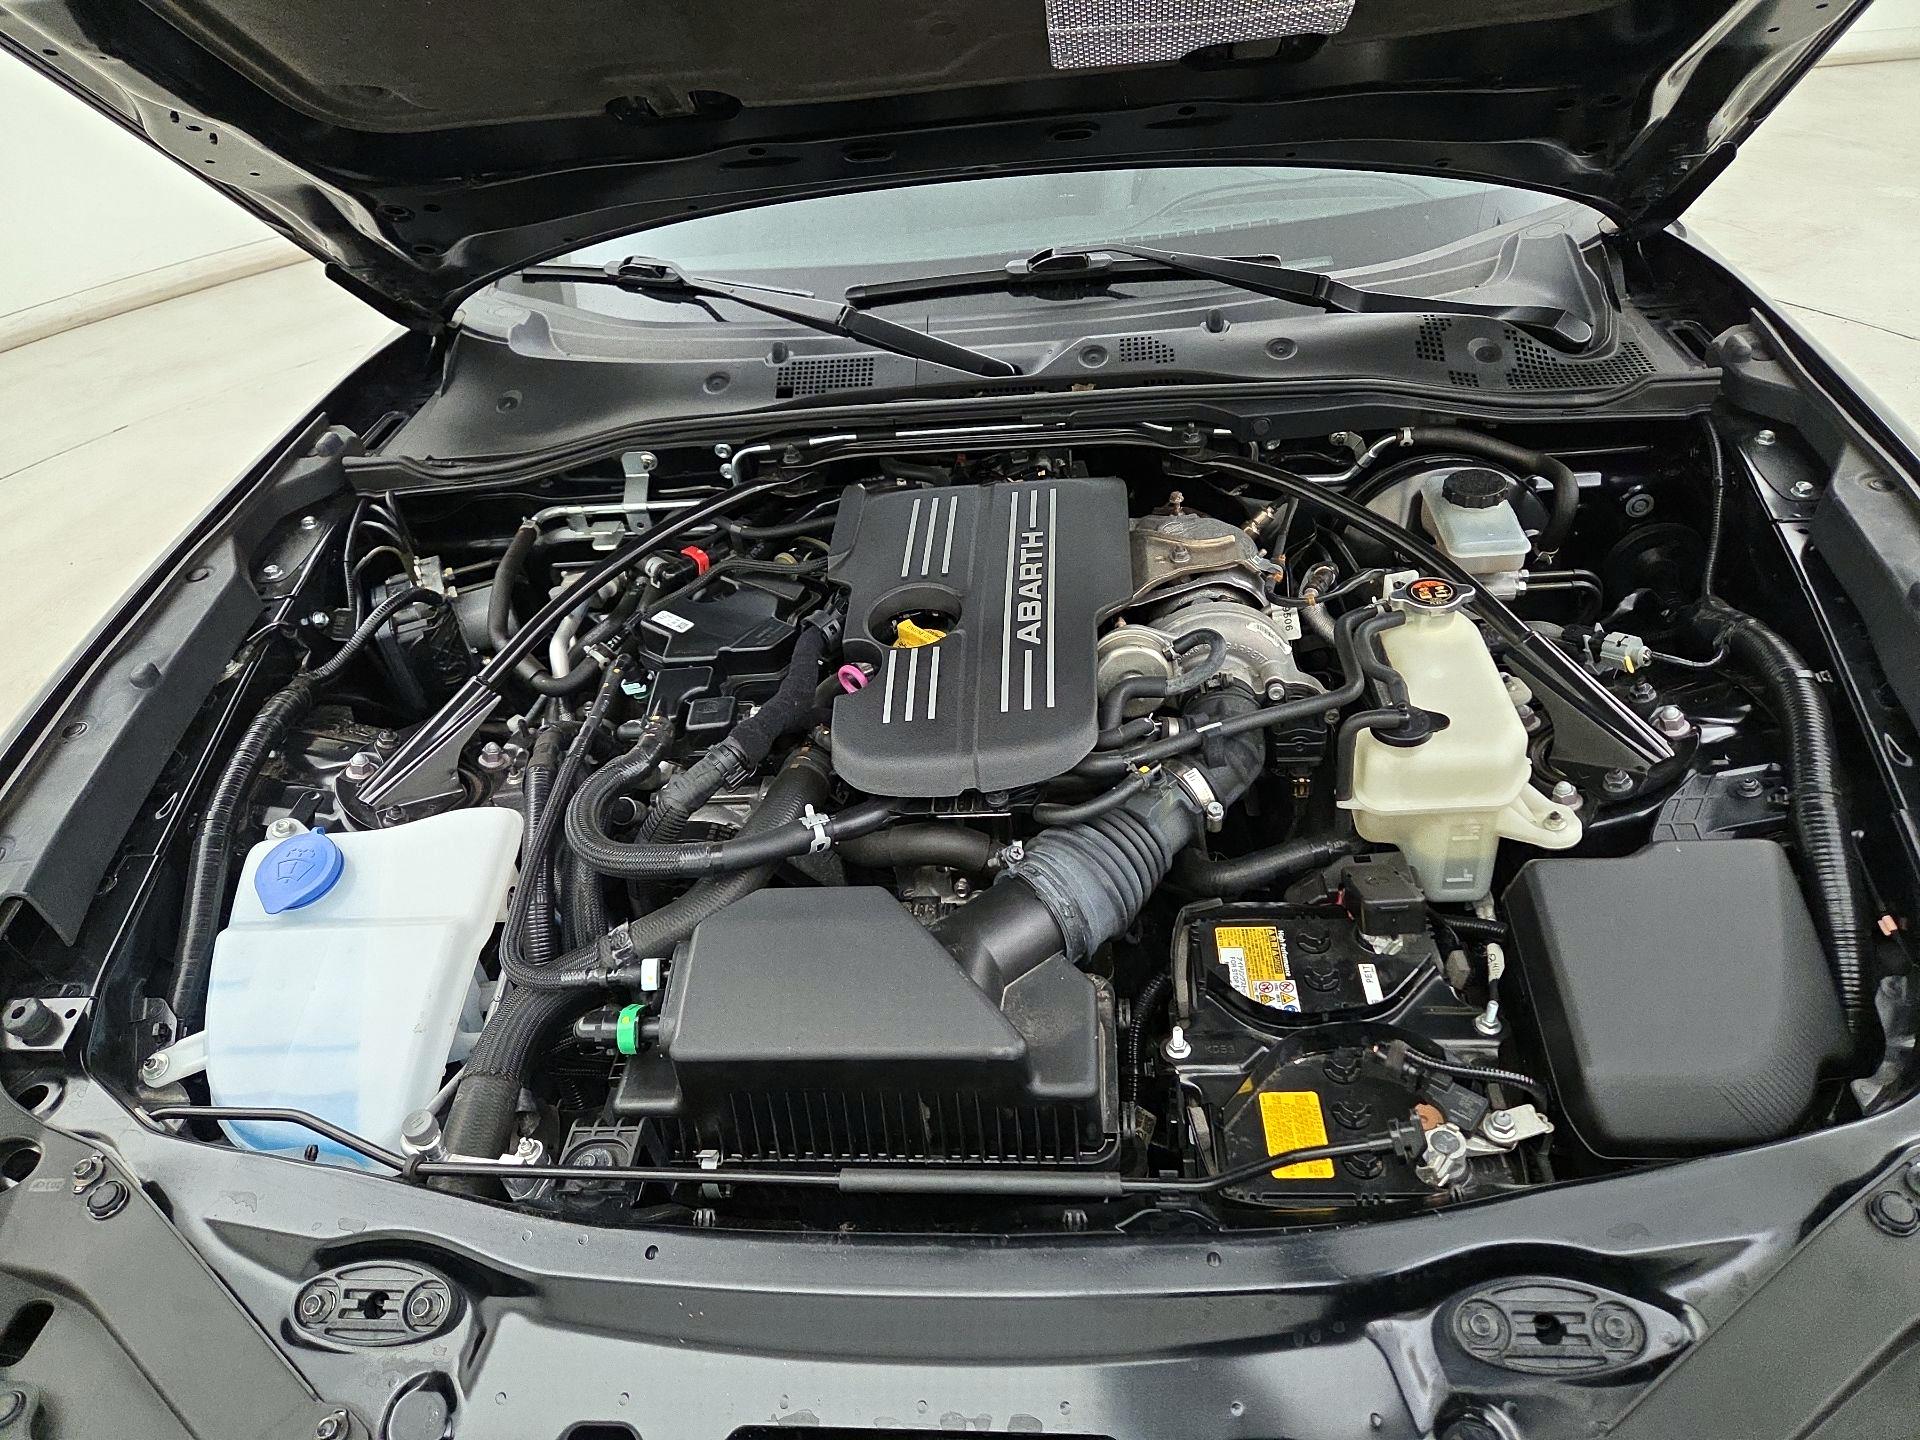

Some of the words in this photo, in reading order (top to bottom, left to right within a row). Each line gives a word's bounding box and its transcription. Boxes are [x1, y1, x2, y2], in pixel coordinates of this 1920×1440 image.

[1016, 531, 1044, 645] ABARTH
[1277, 929, 1287, 943] High
[1280, 943, 1292, 977] Performance
